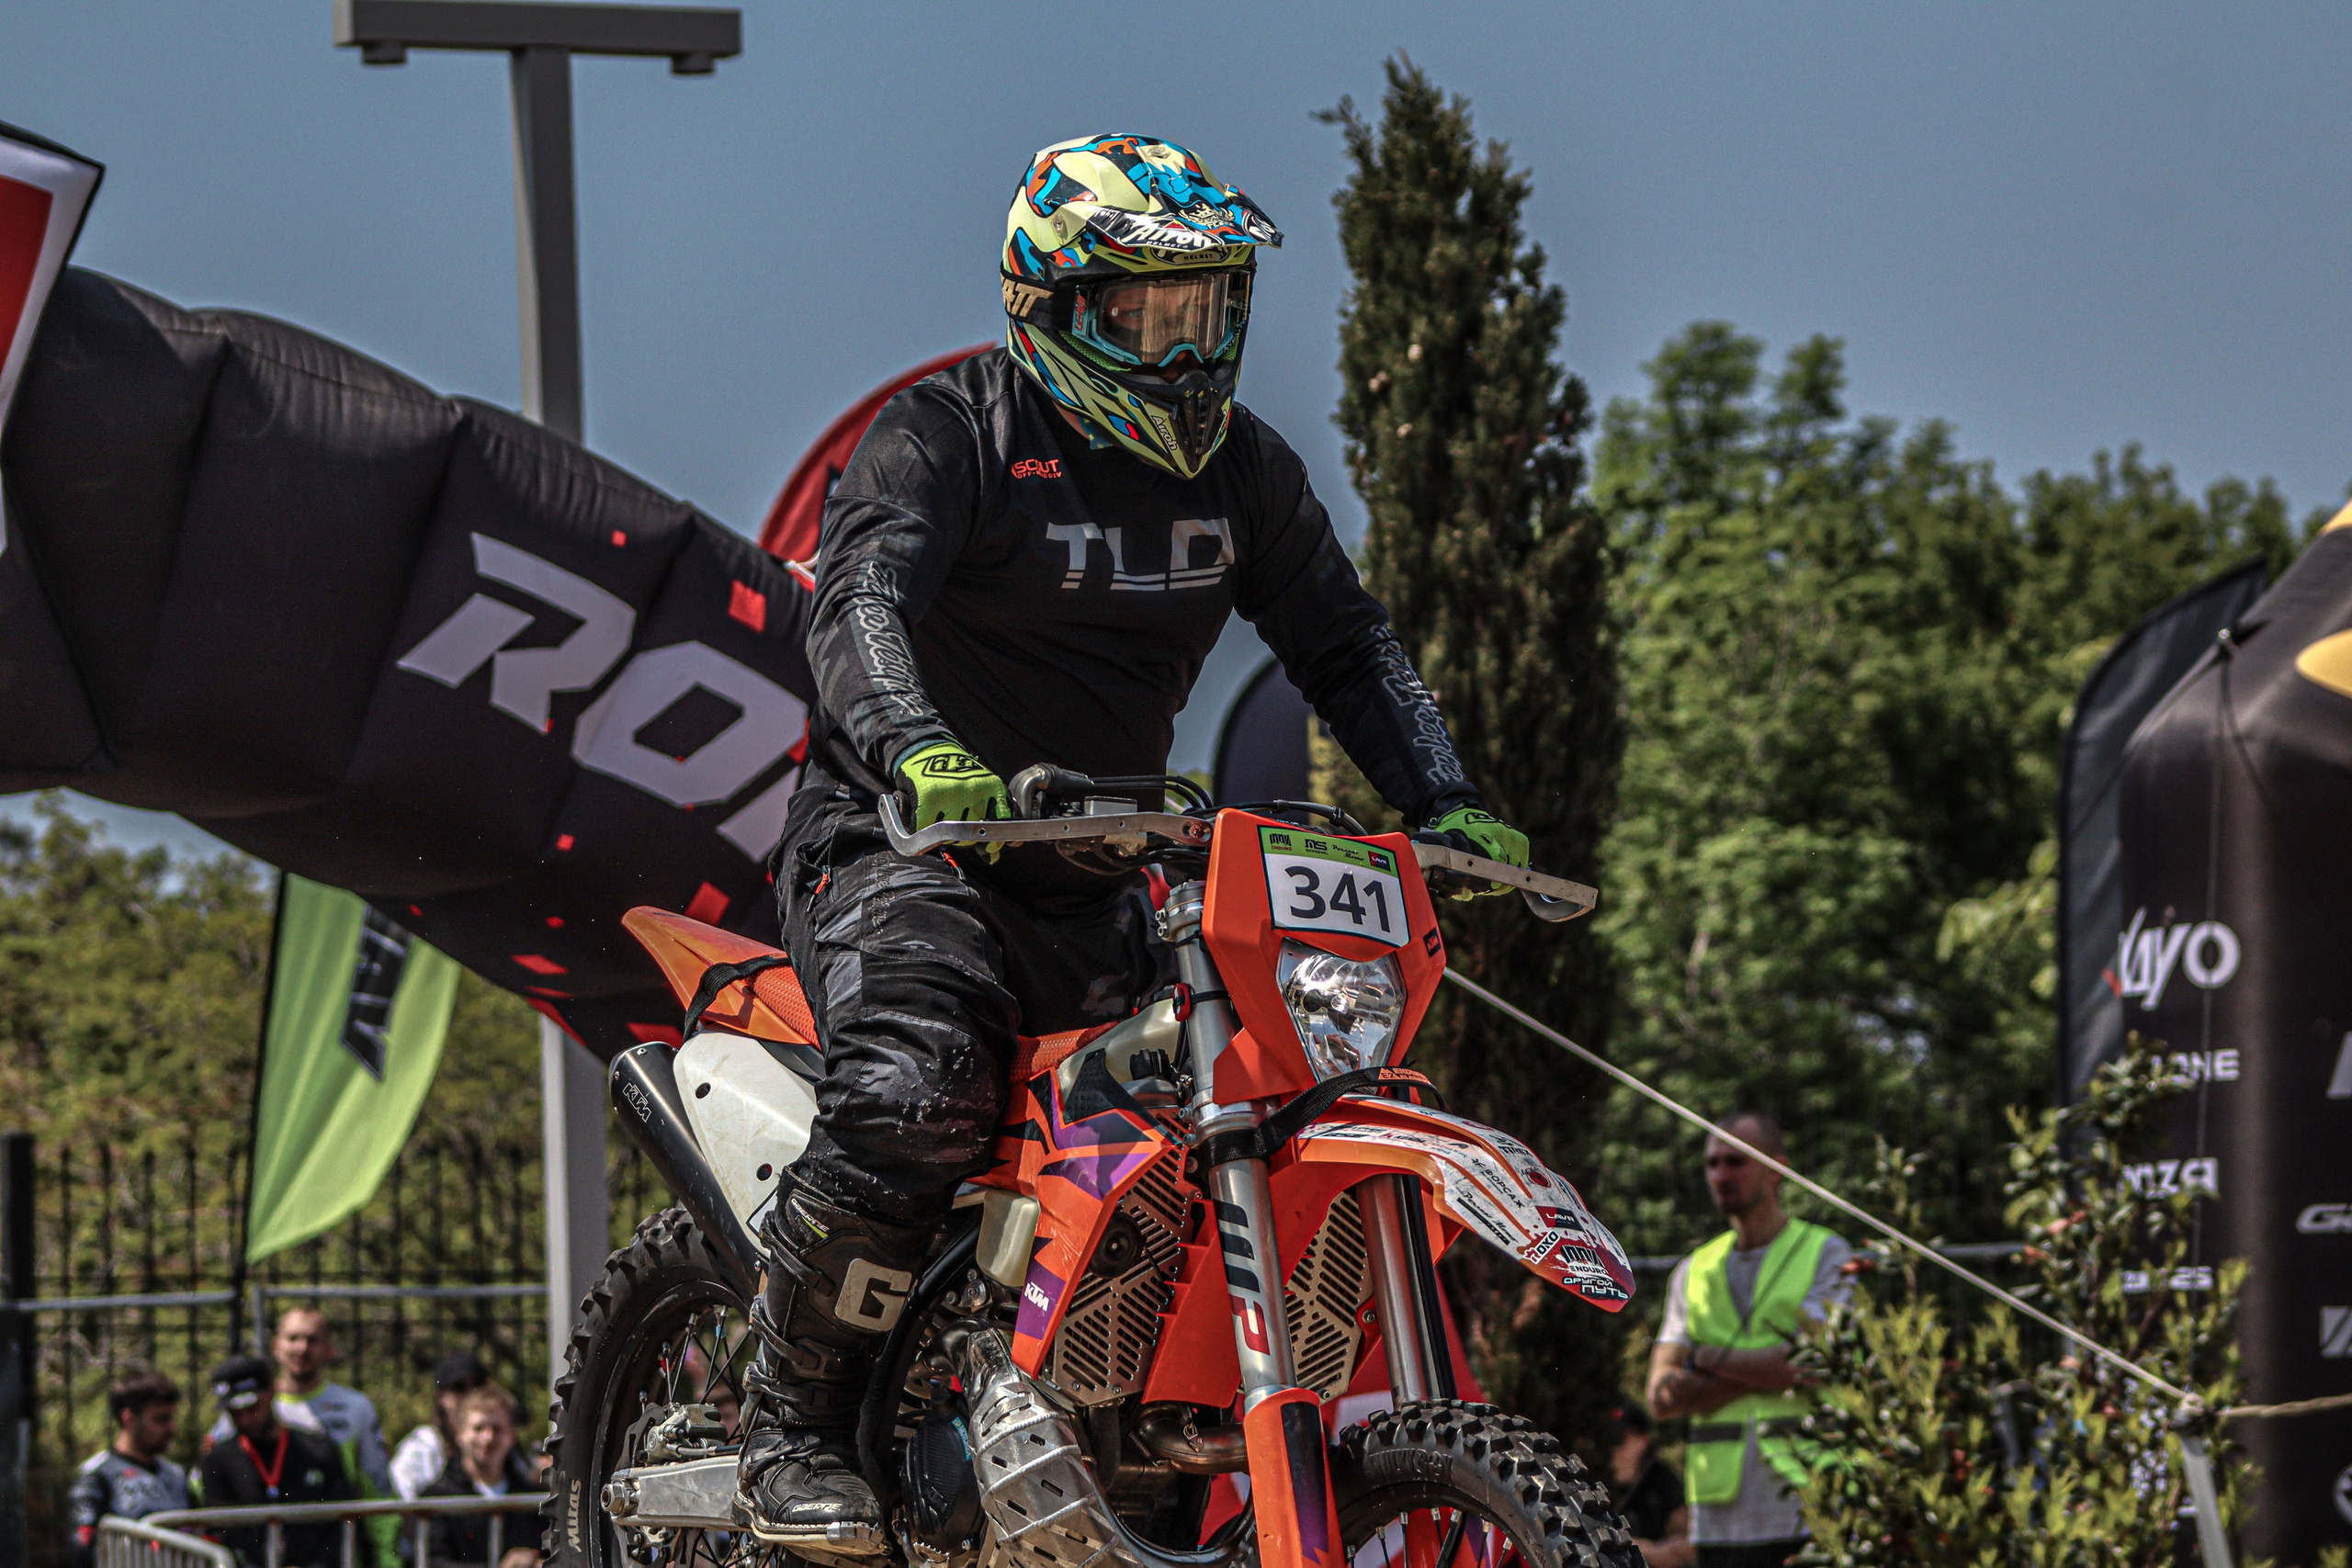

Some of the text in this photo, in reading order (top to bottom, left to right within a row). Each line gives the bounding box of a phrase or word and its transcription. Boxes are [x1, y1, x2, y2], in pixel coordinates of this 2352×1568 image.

[1183, 253, 1214, 261] HELMET
[1151, 415, 1178, 451] Airoh
[1046, 517, 1235, 591] TLD
[1284, 865, 1390, 933] 341
[1427, 935, 1439, 953] KTM
[622, 1082, 651, 1122] KTM
[1545, 1213, 1576, 1223] LAVR
[1569, 1266, 1609, 1275] ENDURO
[1564, 1277, 1613, 1288] ДРУГОЙ
[1024, 1282, 1049, 1312] KTM
[1581, 1284, 1629, 1300] ПУТЬ
[568, 1479, 582, 1552] Mitas
[791, 1502, 842, 1513] GAERNE
